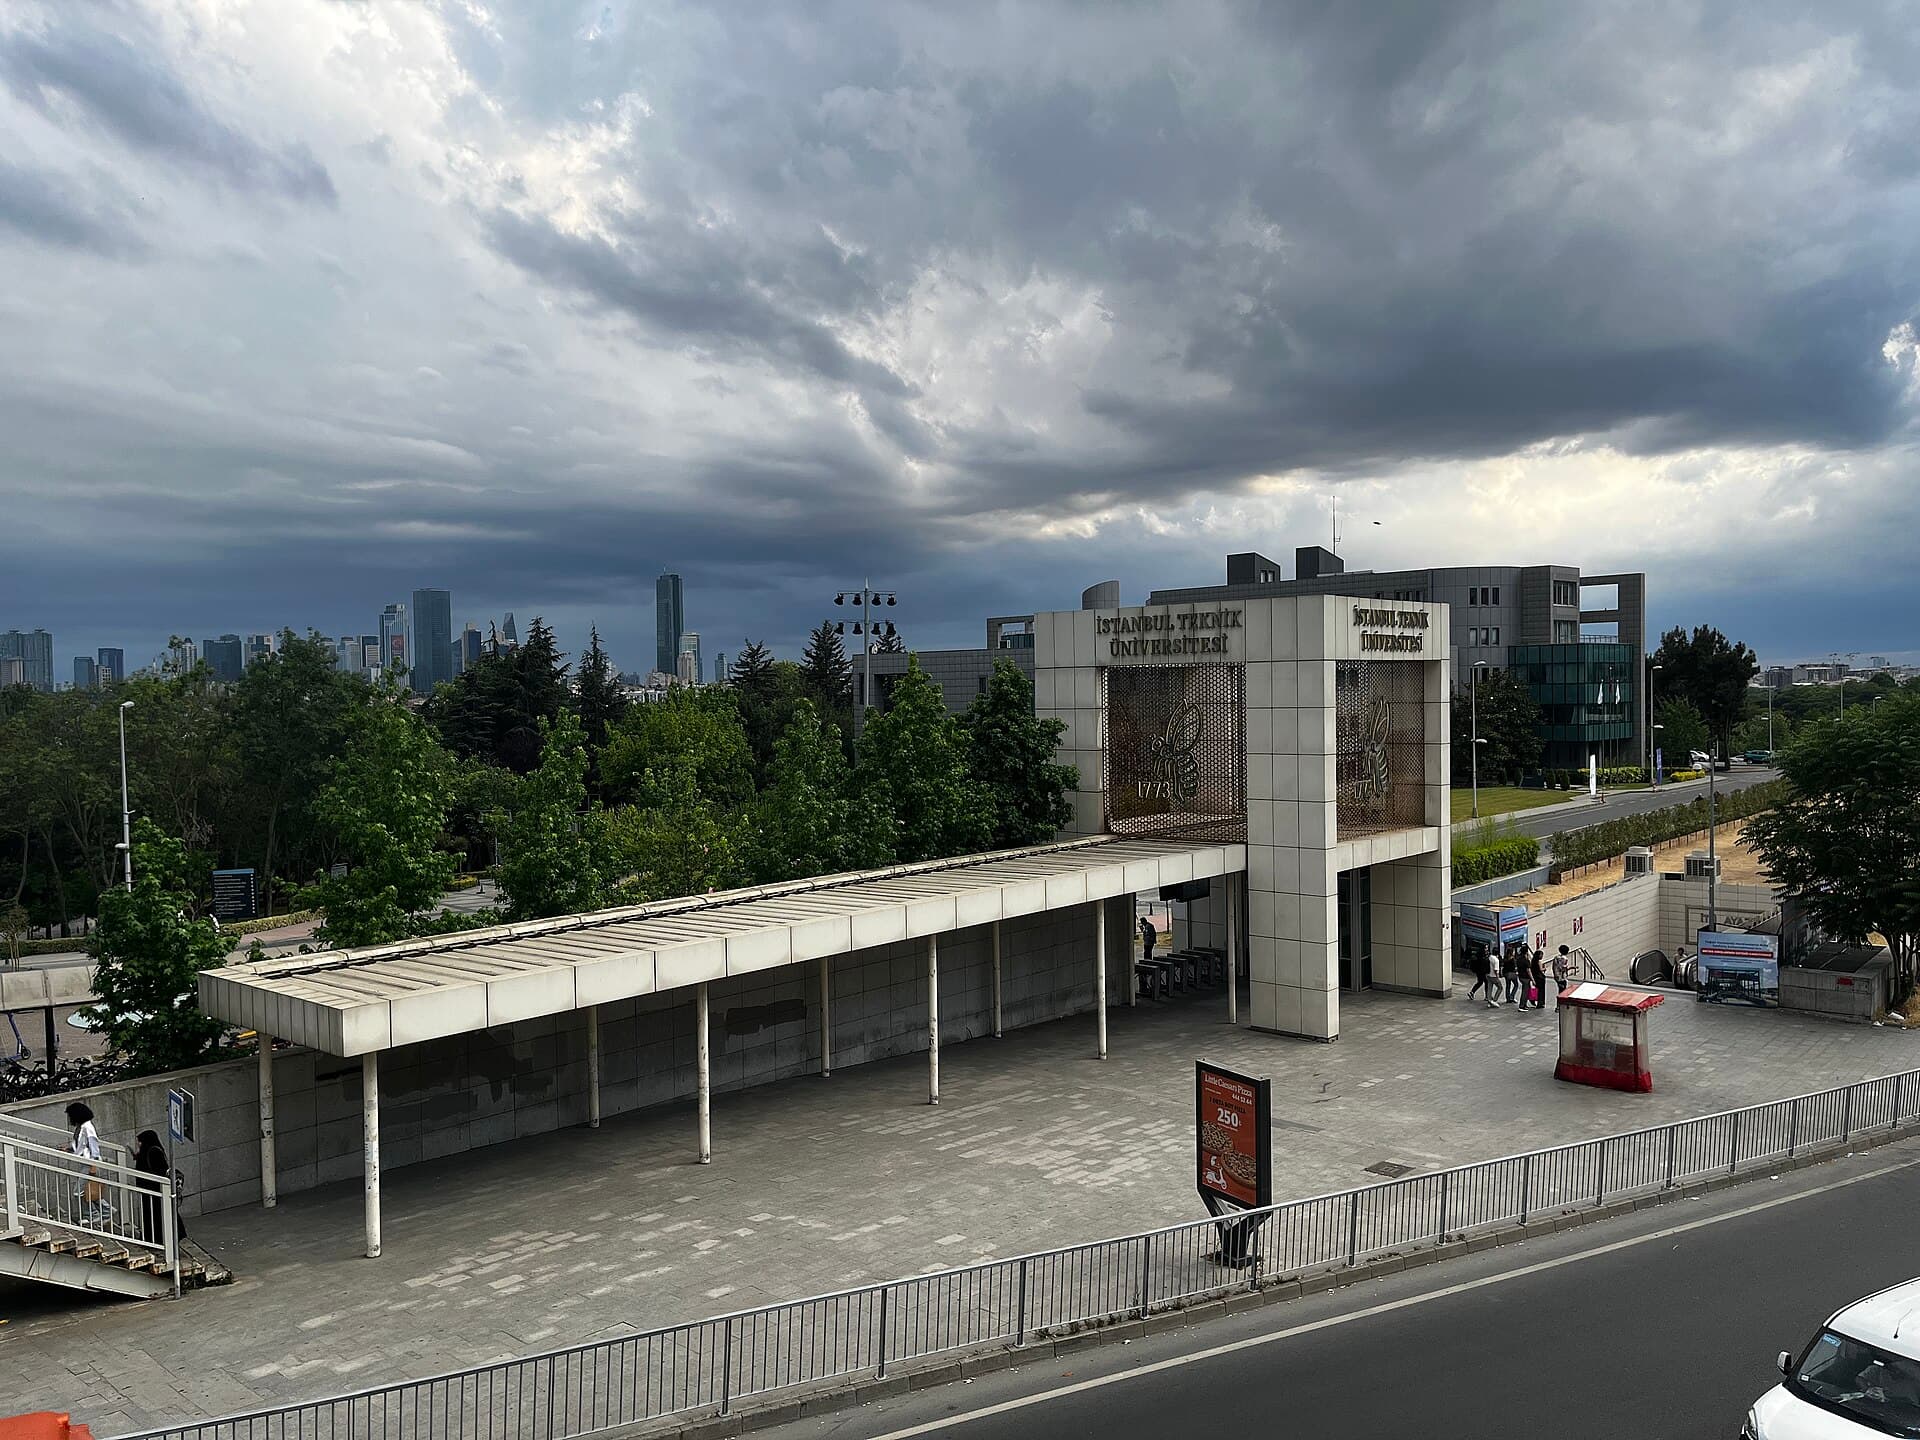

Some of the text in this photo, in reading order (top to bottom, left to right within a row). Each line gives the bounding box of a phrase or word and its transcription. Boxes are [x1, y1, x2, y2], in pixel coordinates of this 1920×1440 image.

[1096, 607, 1243, 634] İSTANBUL TEKNİK
[1353, 604, 1430, 629] İSTANBUL TEKNİK
[1109, 632, 1229, 657] ÜNİVERSİTESİ
[1361, 630, 1423, 653] ÜNİVERSİTESİ
[1138, 781, 1171, 799] 1773
[1204, 1073, 1218, 1086] Little
[1237, 1084, 1253, 1098] Pizza
